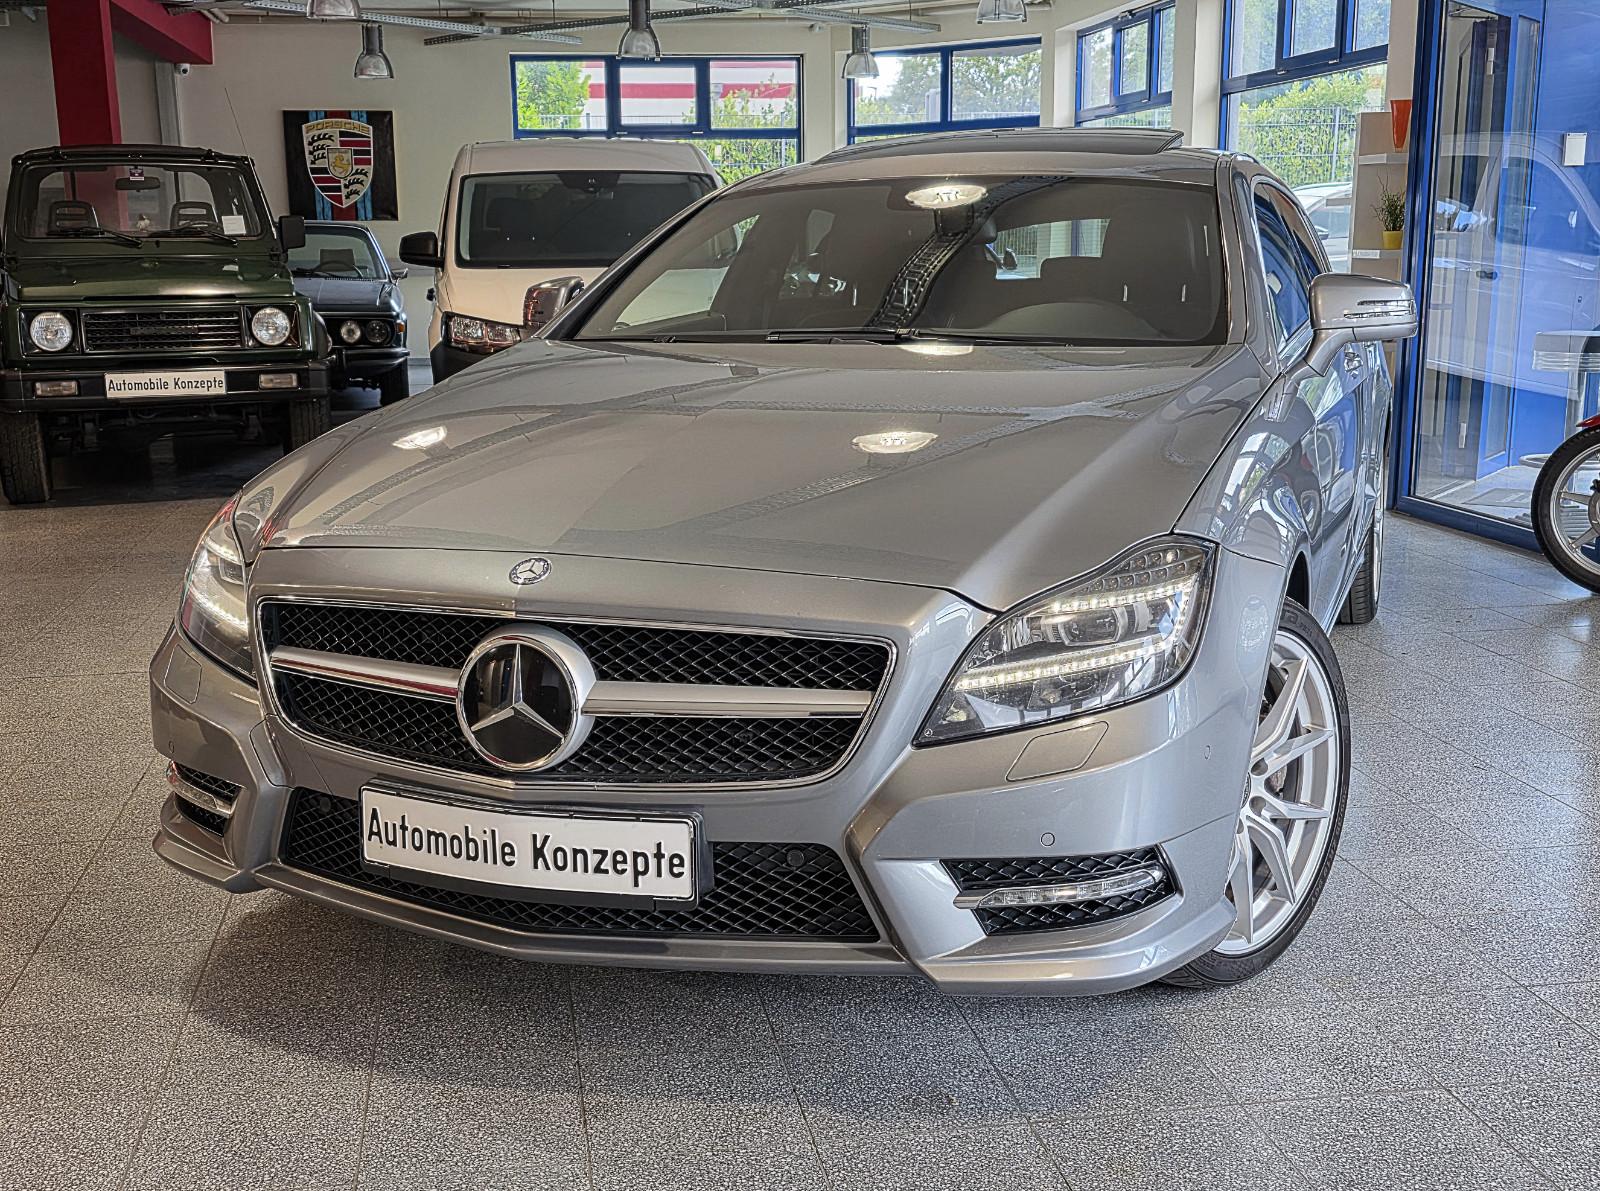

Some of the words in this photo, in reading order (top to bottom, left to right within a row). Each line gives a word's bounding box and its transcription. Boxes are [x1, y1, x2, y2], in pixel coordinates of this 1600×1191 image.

[305, 121, 369, 133] PORSCHE
[108, 379, 169, 391] Automobile
[173, 377, 224, 391] Konzepte
[367, 808, 516, 867] Automobile
[532, 833, 686, 888] Konzepte
